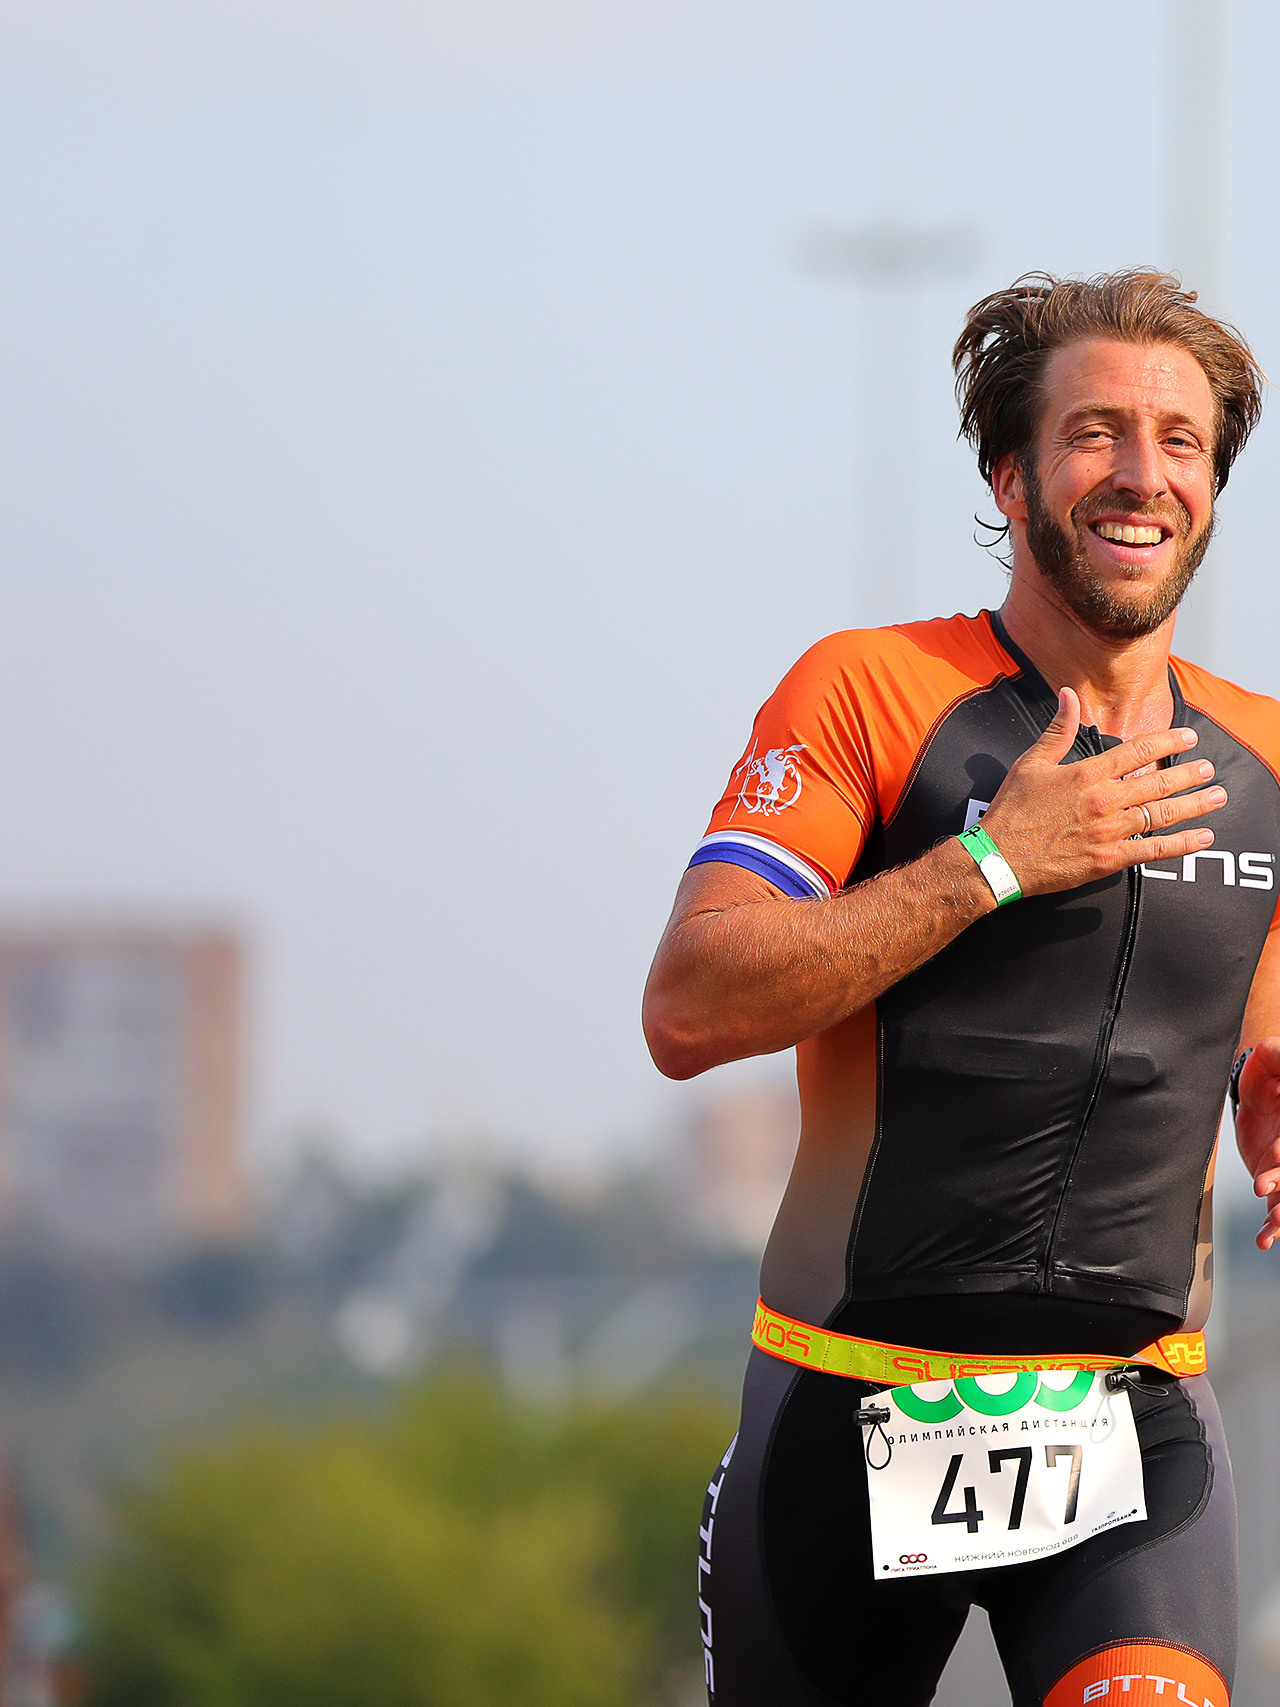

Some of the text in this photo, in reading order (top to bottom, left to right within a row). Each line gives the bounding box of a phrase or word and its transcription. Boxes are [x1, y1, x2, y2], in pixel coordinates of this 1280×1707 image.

[888, 1417, 1109, 1446] ОЛИМПИЙСКАЯ ДИСТАНЦИЯ
[931, 1444, 1084, 1534] 477
[954, 1542, 1061, 1563] НИЖНИЙ НОВГОРОД
